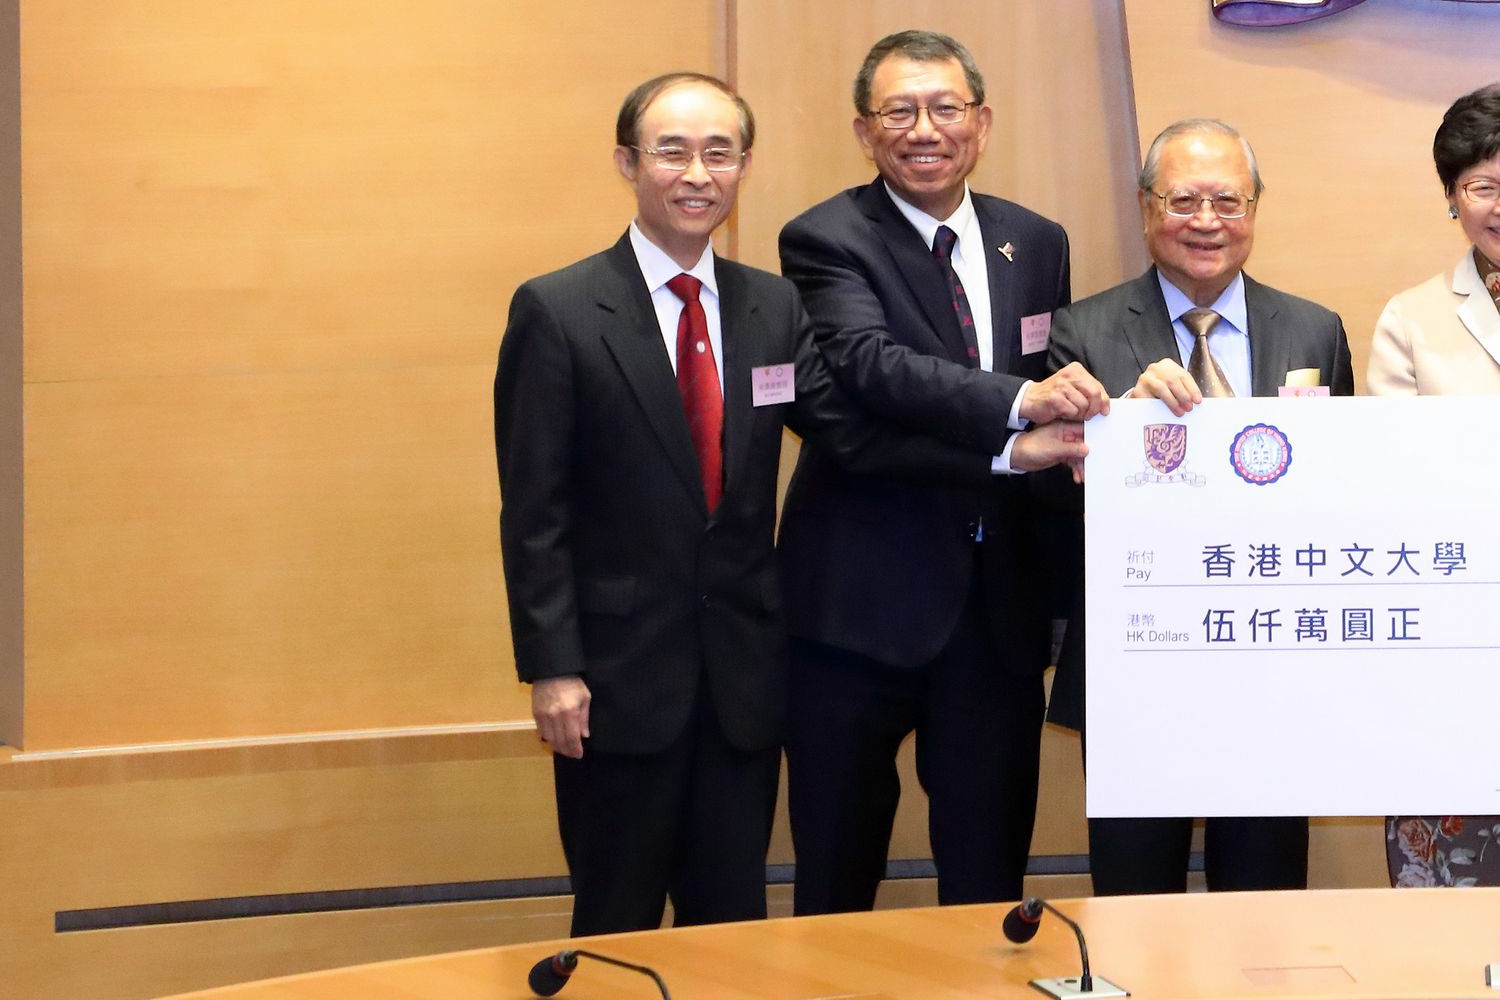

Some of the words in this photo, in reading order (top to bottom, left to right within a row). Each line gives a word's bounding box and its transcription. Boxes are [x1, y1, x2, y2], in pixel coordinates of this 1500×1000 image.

[1202, 541, 1468, 579] 香港中文大學
[1126, 567, 1152, 582] Pay
[1126, 630, 1146, 642] HK
[1148, 629, 1190, 642] Dollars
[1202, 608, 1422, 644] 伍仟萬圓正
